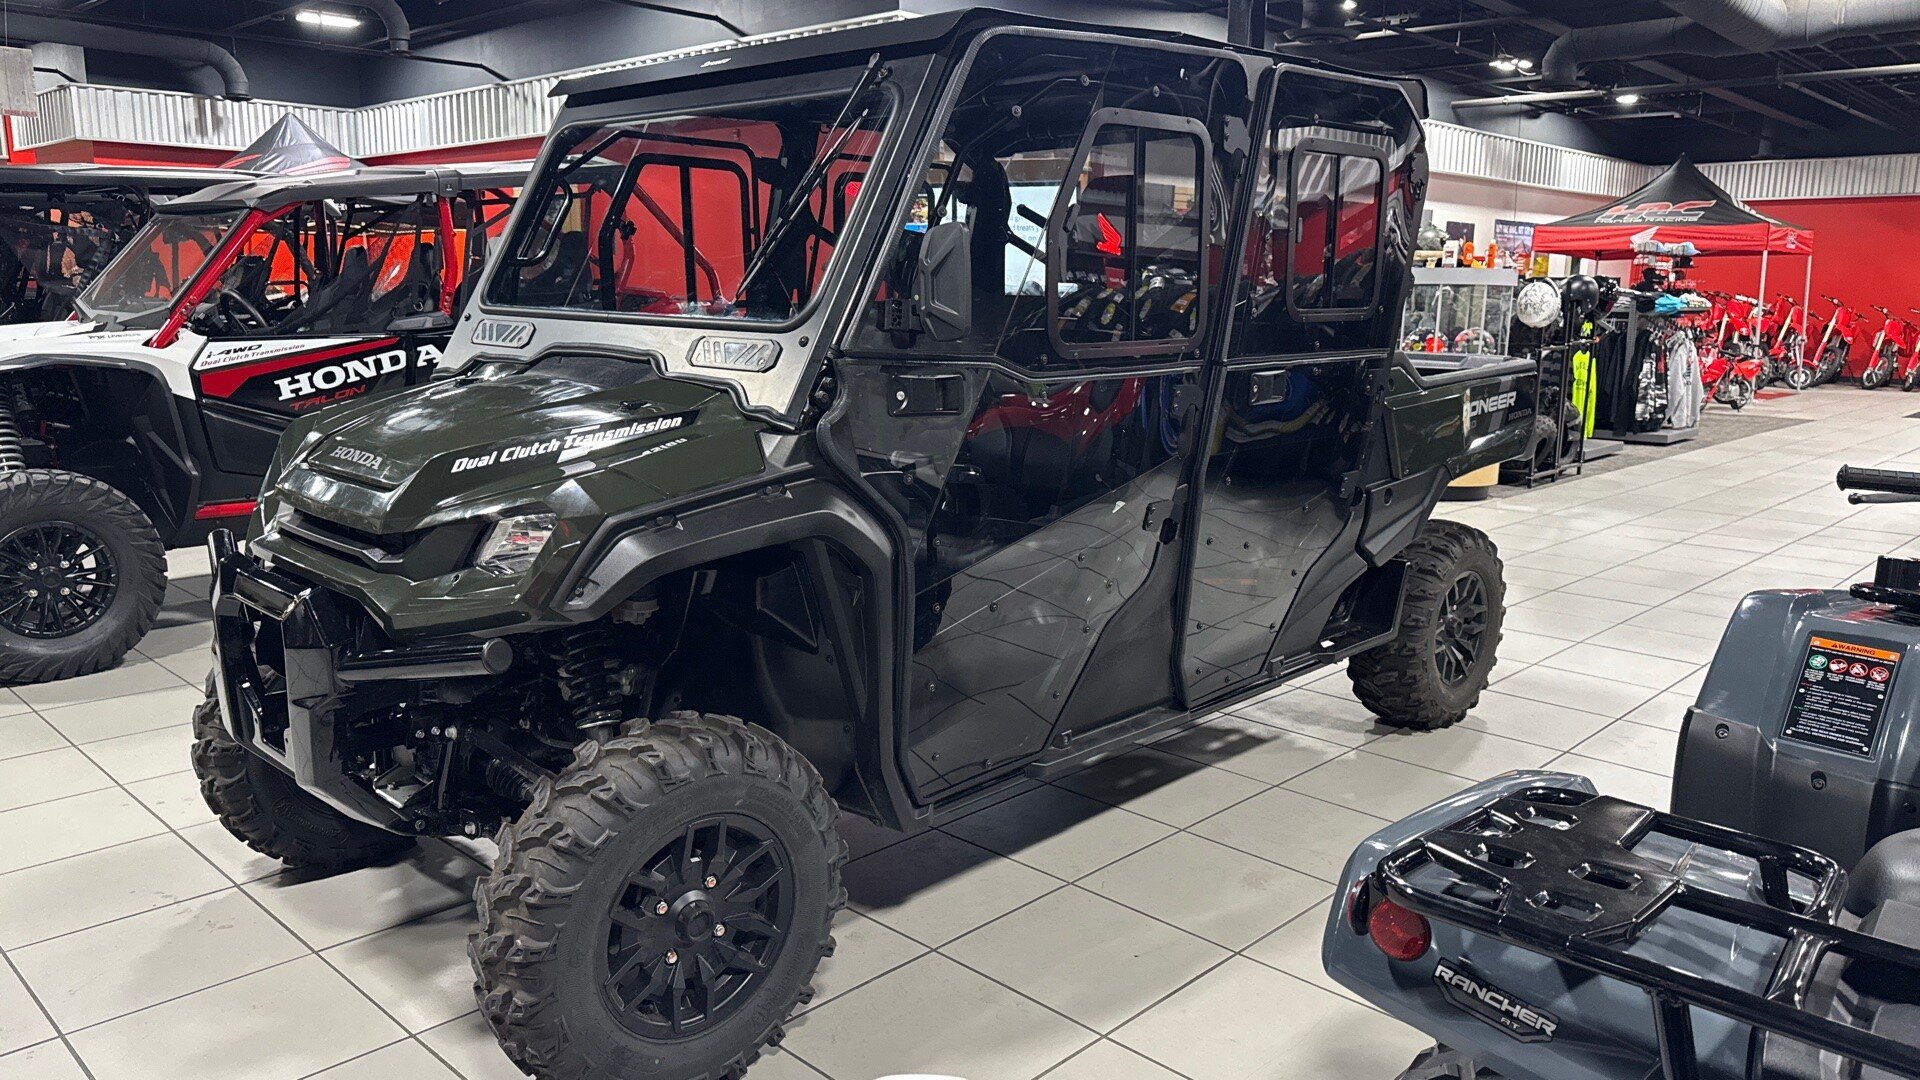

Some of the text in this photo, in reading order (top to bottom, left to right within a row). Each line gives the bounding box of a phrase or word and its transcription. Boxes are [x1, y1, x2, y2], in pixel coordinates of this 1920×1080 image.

[200, 344, 305, 367] Dual Clutch Transmission
[289, 384, 366, 411] TALON
[1464, 391, 1517, 418] ONEER
[1508, 407, 1532, 421] HONDA
[330, 445, 384, 470] HONDA
[450, 451, 498, 473] Dual
[499, 438, 560, 462] Clutch
[562, 416, 683, 451] Transmission
[1837, 643, 1876, 656] WARNING
[1434, 964, 1557, 1037] RANCHER
